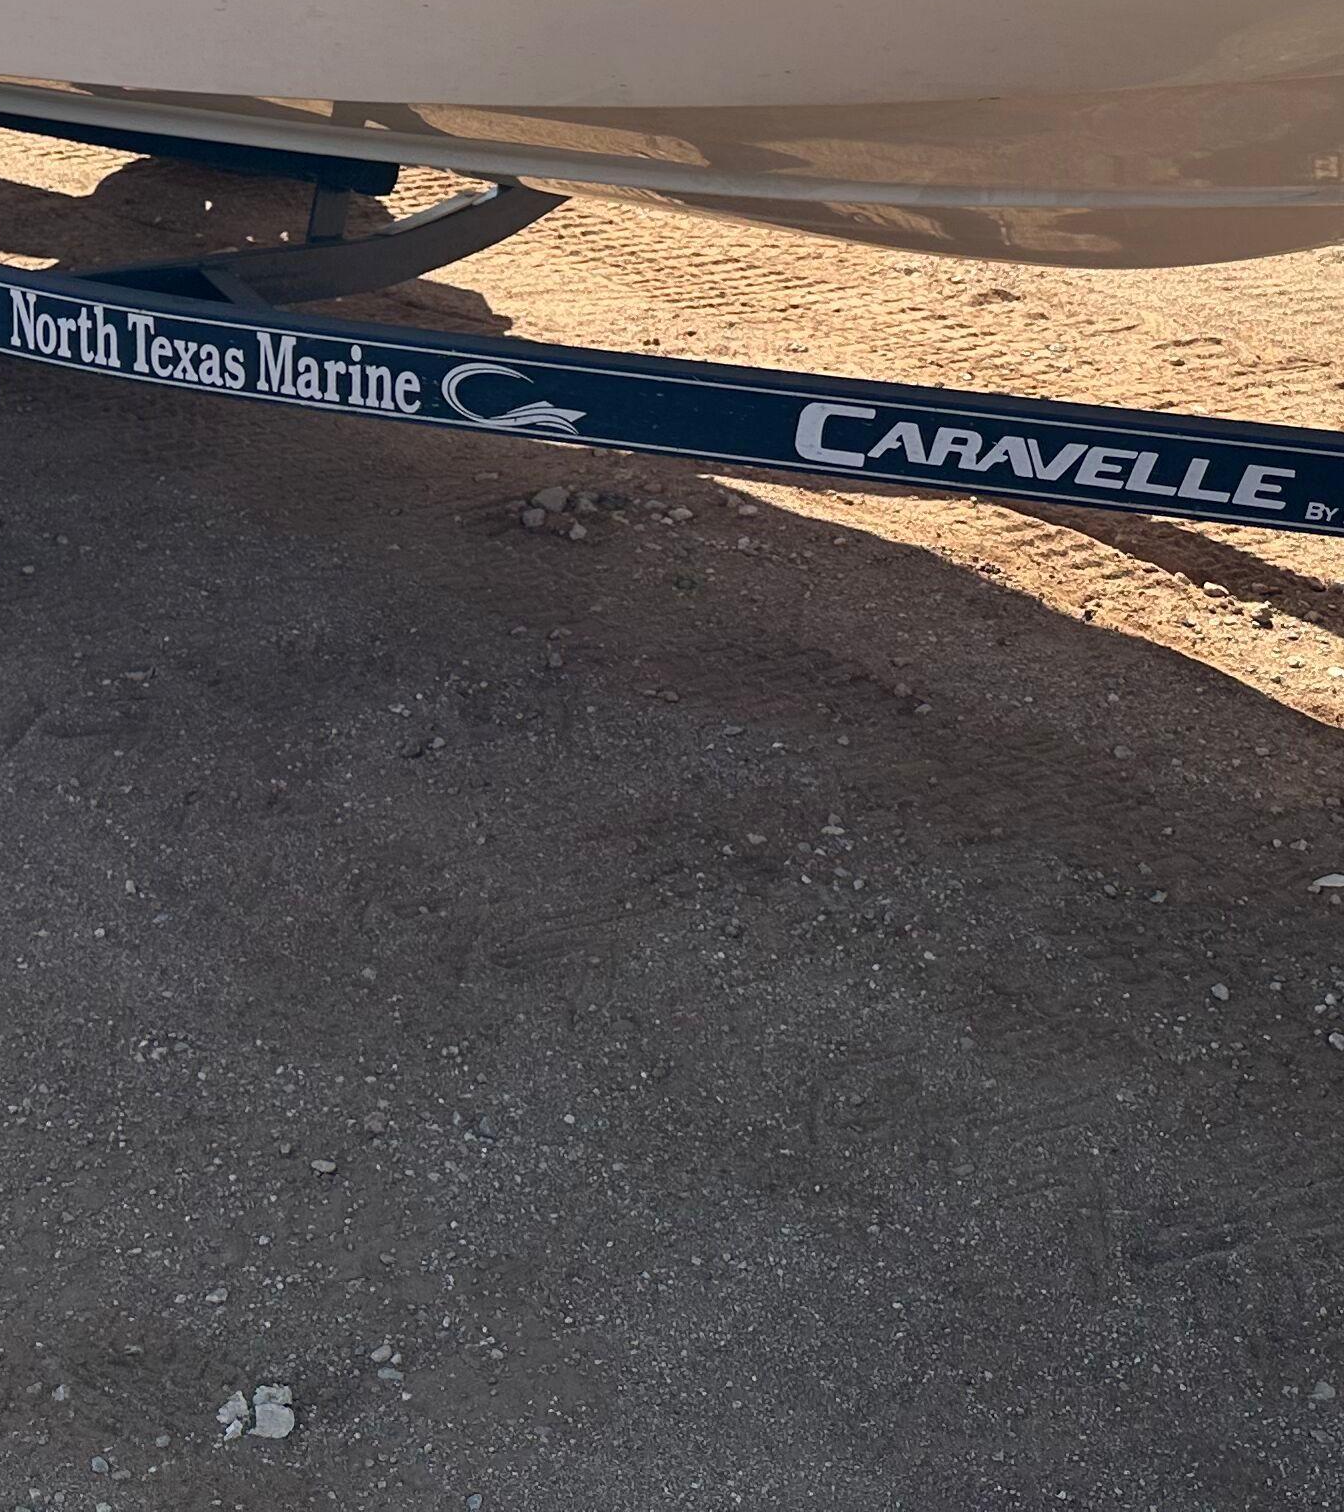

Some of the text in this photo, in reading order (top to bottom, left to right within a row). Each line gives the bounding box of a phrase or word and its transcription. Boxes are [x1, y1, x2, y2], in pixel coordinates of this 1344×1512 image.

[9, 287, 422, 415] North Texas Marine
[794, 401, 1296, 510] CARAVELLE
